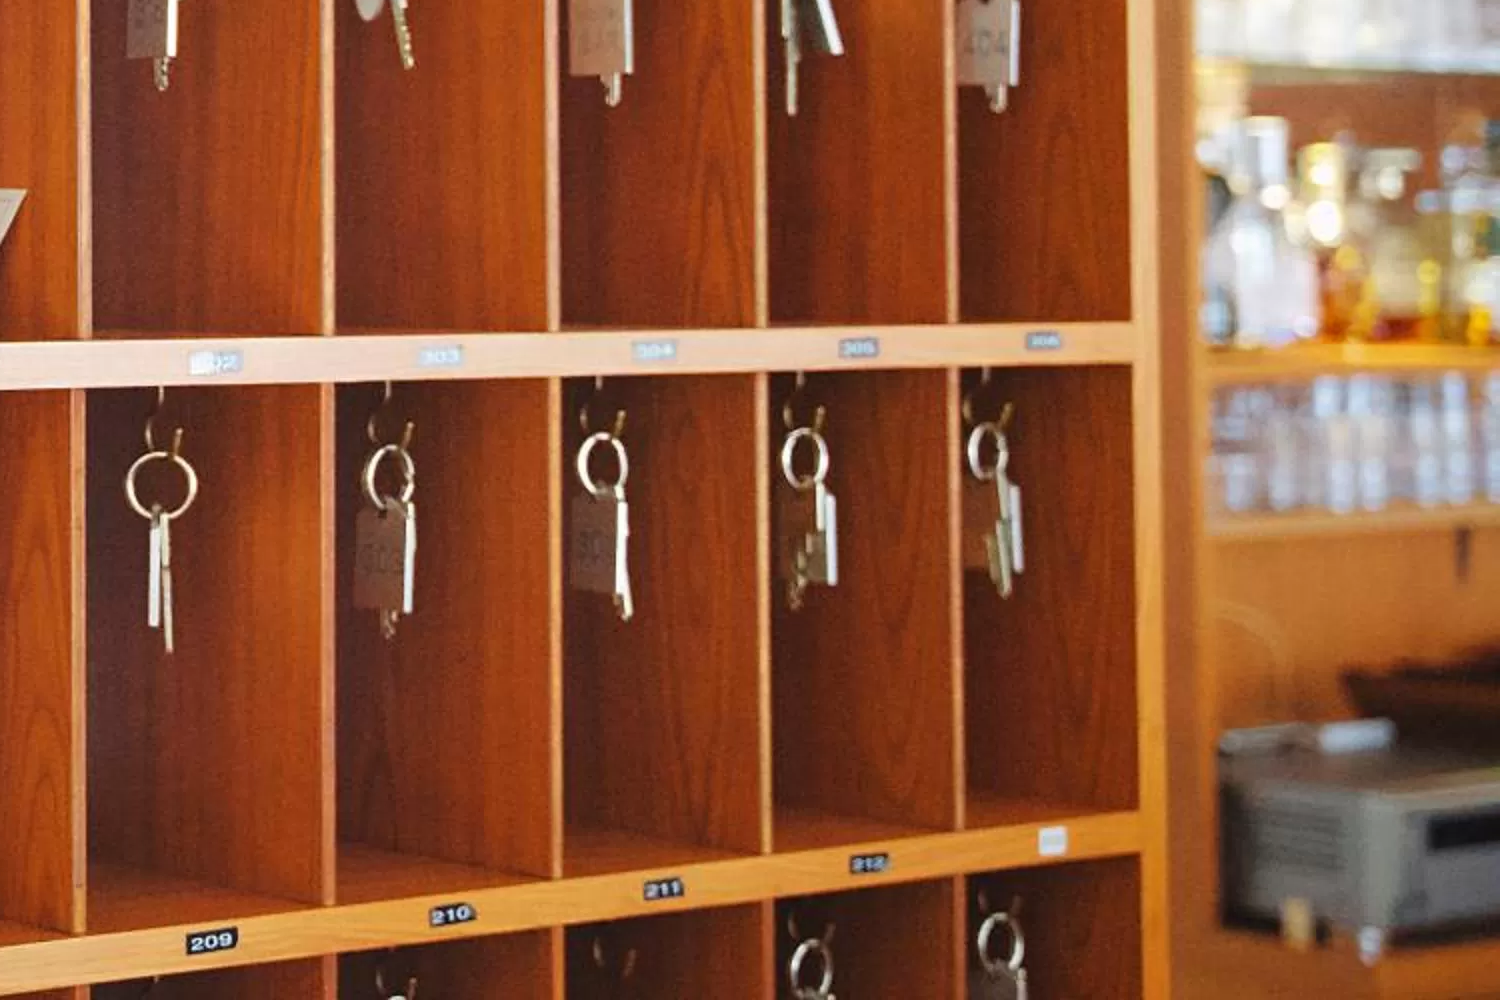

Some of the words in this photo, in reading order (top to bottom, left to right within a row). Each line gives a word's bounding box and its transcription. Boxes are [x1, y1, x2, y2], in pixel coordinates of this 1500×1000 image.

[644, 880, 679, 898] 211
[431, 904, 471, 925] 210
[191, 932, 233, 951] 209
